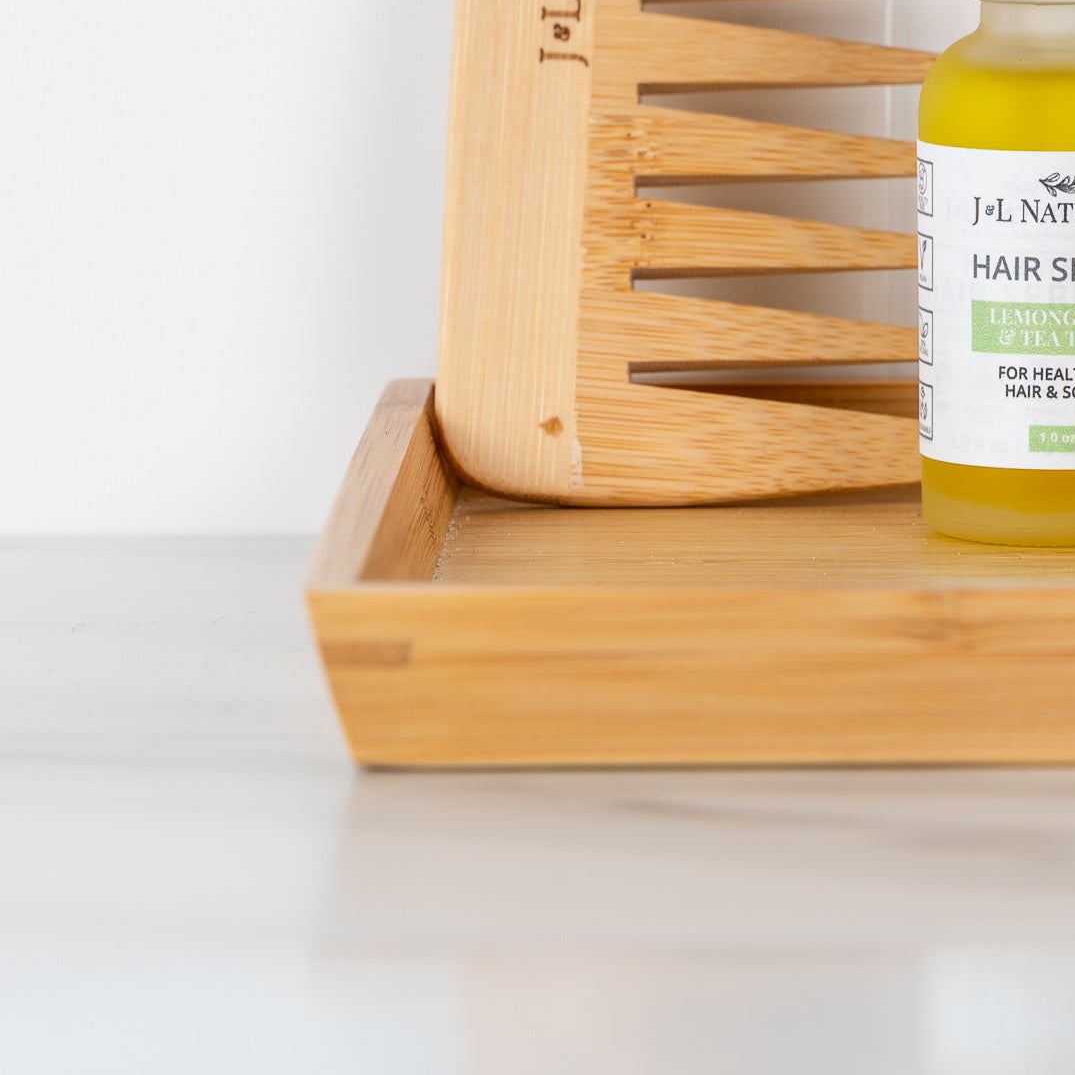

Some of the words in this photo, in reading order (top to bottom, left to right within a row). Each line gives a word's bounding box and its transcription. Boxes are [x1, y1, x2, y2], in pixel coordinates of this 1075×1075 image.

[973, 253, 1042, 282] HAIR
[1000, 329, 1015, 346] &
[1020, 330, 1060, 347] TEA
[998, 365, 1028, 380] FOR
[1005, 384, 1042, 399] HAIR
[1046, 385, 1058, 399] &
[1039, 431, 1058, 443] 1.0
[1061, 433, 1075, 443] oz
